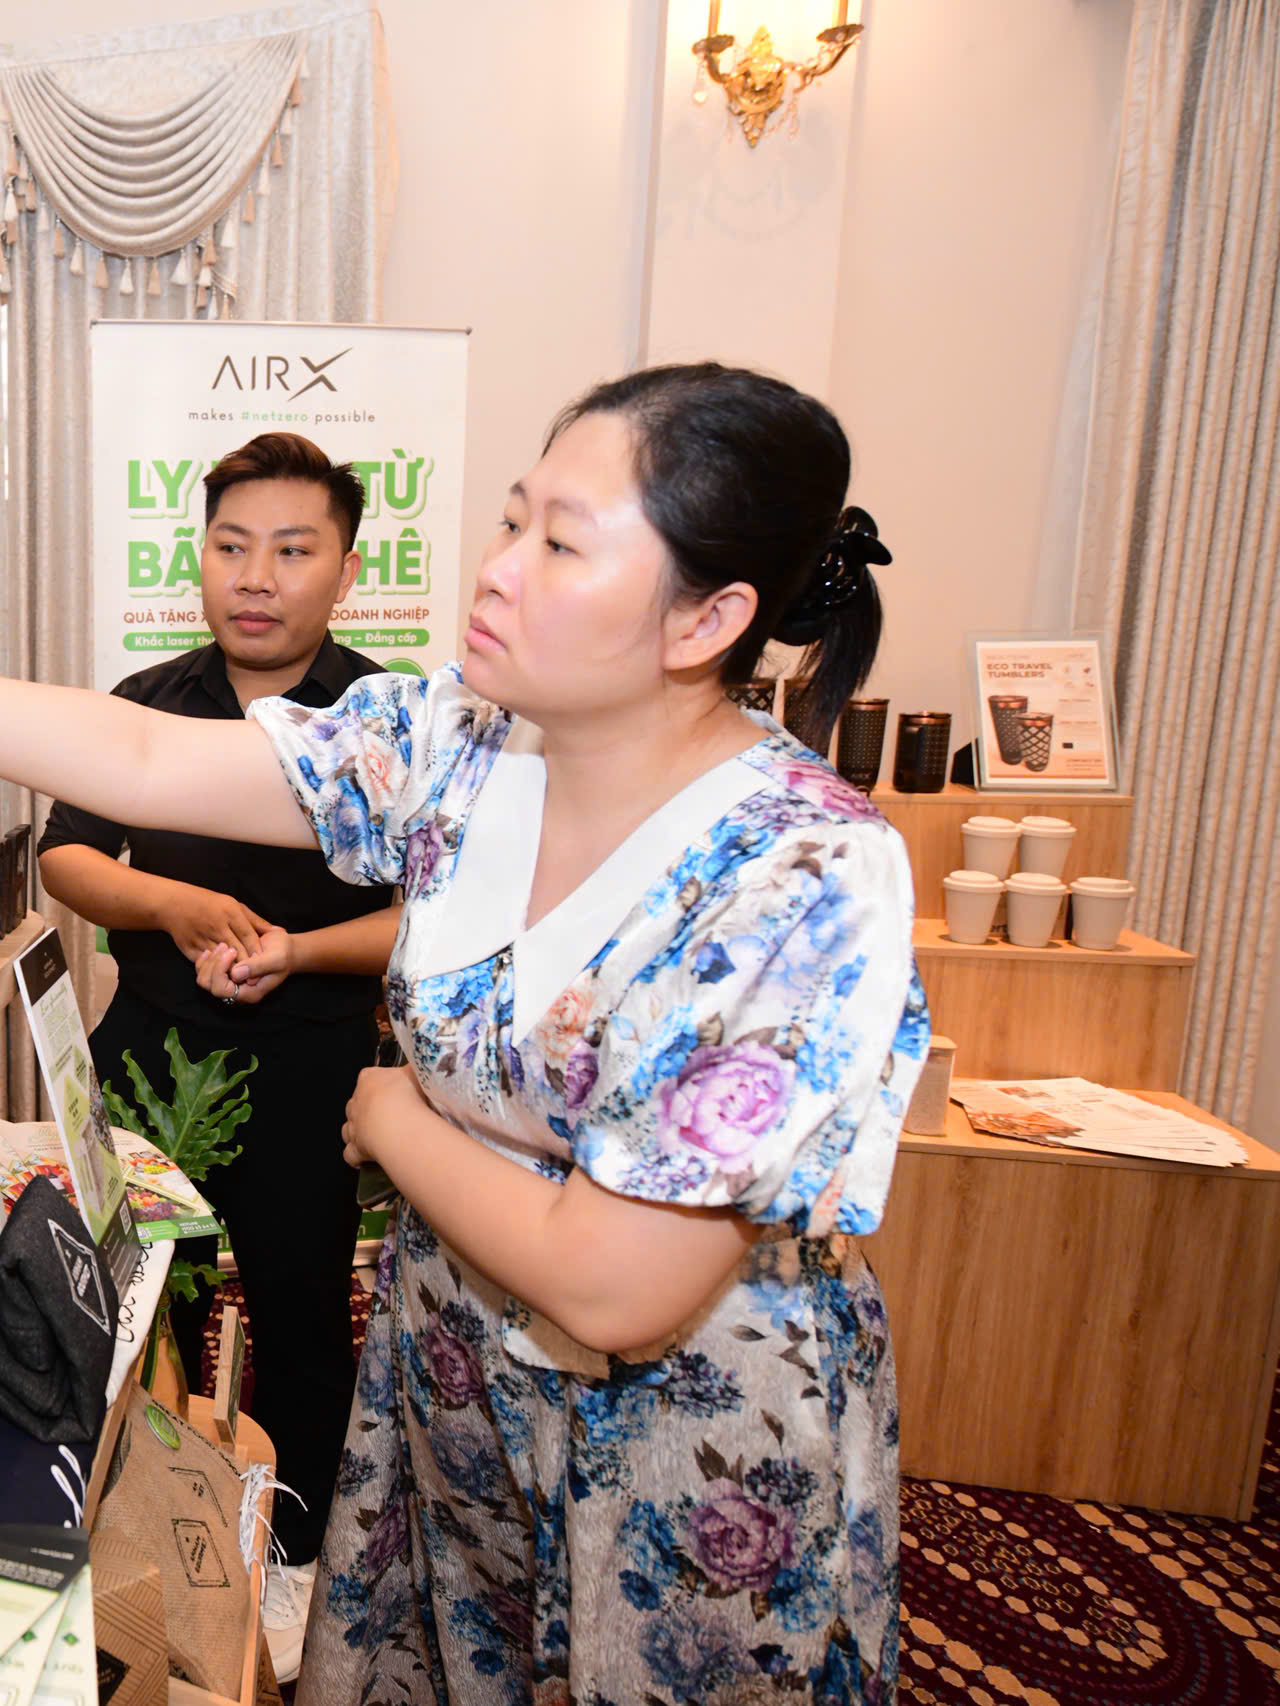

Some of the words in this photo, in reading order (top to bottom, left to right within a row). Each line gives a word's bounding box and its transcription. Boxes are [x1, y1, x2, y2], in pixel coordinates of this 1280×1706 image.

[212, 347, 353, 401] AIRX
[188, 409, 234, 421] makes
[241, 411, 308, 423] #netzero
[314, 411, 376, 425] possible
[128, 459, 193, 508] LY
[353, 448, 425, 510] TỪ
[356, 527, 422, 585] HÊ
[123, 608, 155, 624] QUÀ
[159, 608, 197, 626] TẶNG
[329, 609, 379, 621] DOANH
[383, 605, 430, 623] NGHIỆP
[167, 634, 194, 647] laser
[986, 663, 1009, 671] ECO
[1012, 663, 1054, 671] TRAVEL
[988, 671, 1046, 679] TUMBLERS
